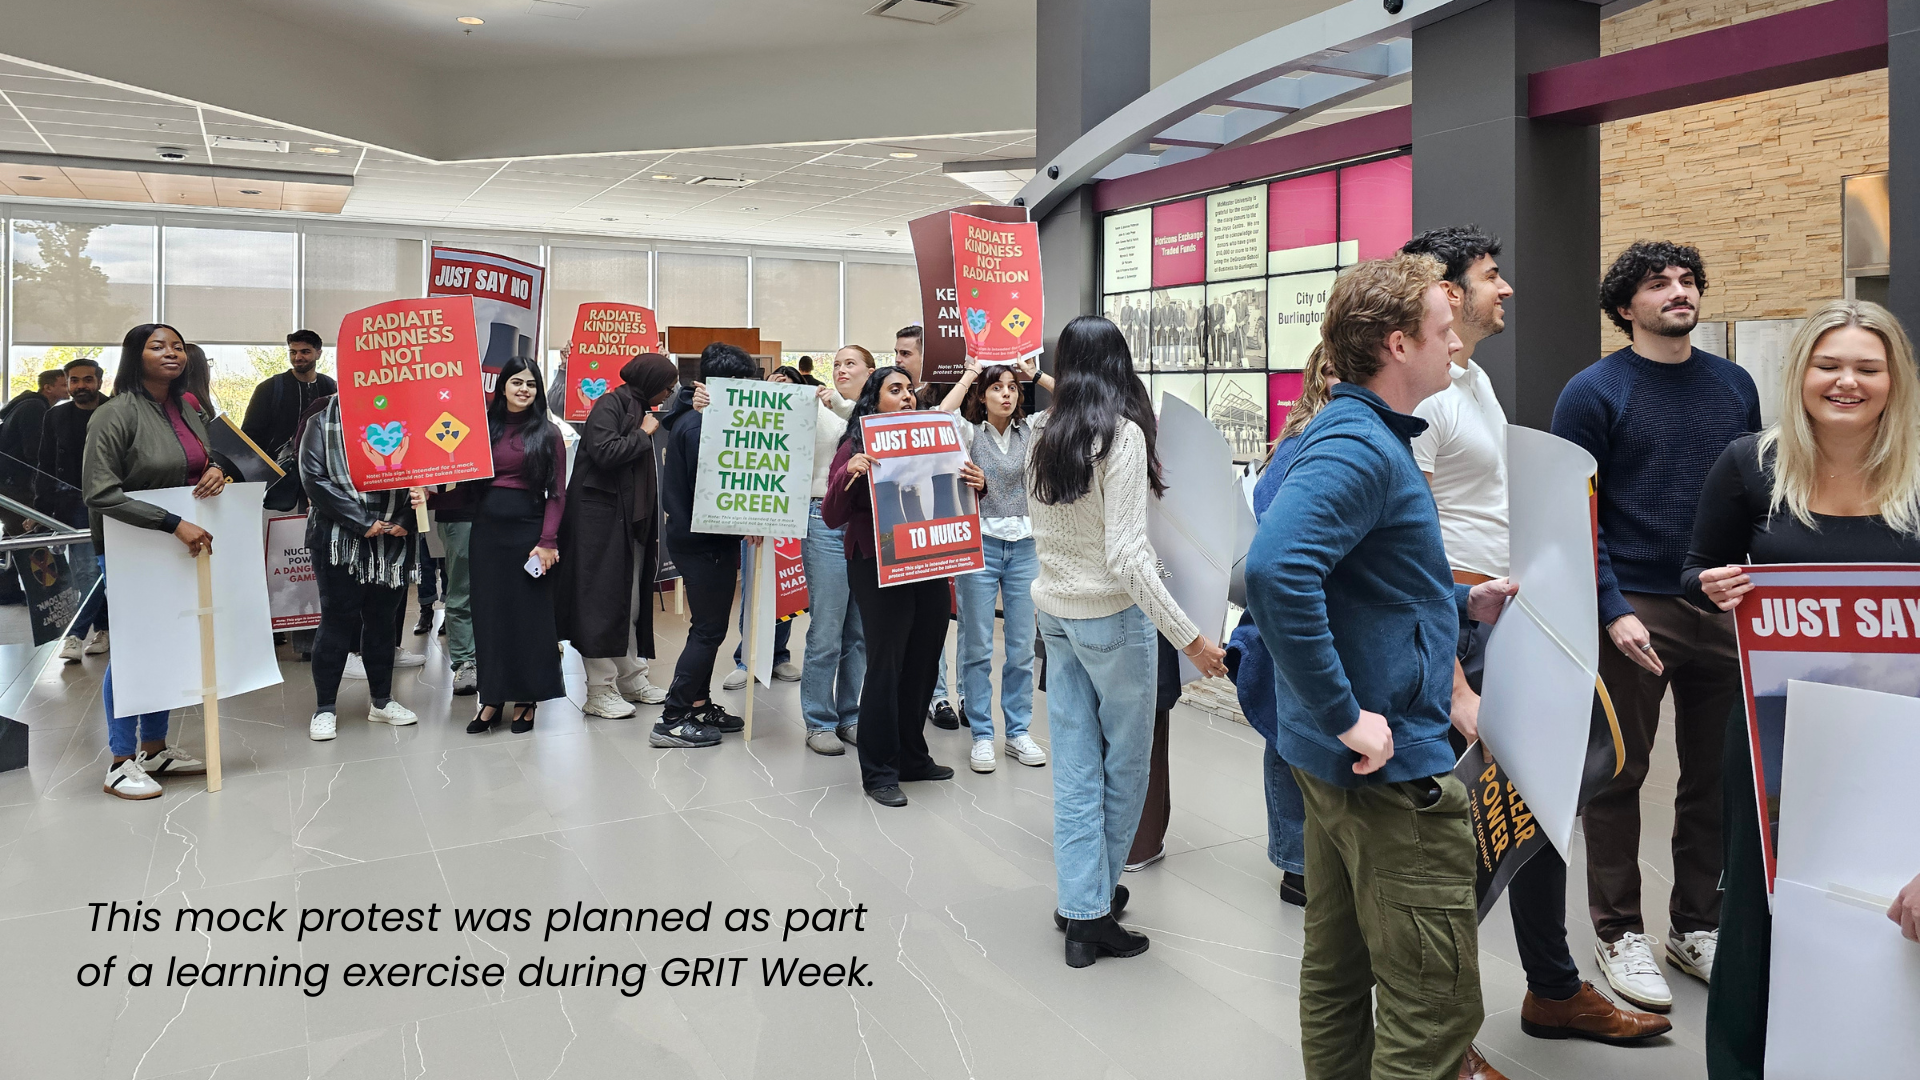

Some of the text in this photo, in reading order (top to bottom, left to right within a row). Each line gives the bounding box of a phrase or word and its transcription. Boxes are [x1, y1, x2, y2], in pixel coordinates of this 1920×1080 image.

[968, 225, 1016, 244] RADIATE
[1155, 231, 1204, 246] Horizons Exchange
[965, 238, 1023, 257] KINDNESS
[1162, 243, 1196, 256] Traded Funds
[977, 255, 1002, 270] NOT
[434, 265, 529, 300] JUST SAY NO
[963, 265, 1029, 283] RADIATION
[1296, 290, 1326, 306] City of
[362, 309, 443, 332] RADIATE
[590, 309, 641, 322] RADIATE
[938, 307, 960, 319] AN
[583, 320, 647, 334] KINDNESS
[356, 326, 454, 351] KINDNESS
[599, 332, 627, 344] NOT
[381, 346, 424, 366] NOT
[579, 343, 650, 356] RADIATION
[354, 361, 463, 388] RADIATION
[726, 388, 793, 411] THINK
[730, 409, 785, 430] SAFE
[722, 429, 790, 451] THINK
[871, 426, 956, 452] JUST SAY NO
[412, 466, 439, 474] intended
[718, 450, 790, 472] CLEAN
[718, 471, 786, 492] THINK
[716, 492, 789, 514] GREEN
[909, 521, 972, 549] TO NUKES
[284, 548, 312, 556] NUCL
[288, 556, 311, 565] POW
[283, 565, 313, 574] DANG
[779, 562, 805, 578] NUC
[1751, 598, 1920, 638] JUST SAY
[1480, 763, 1509, 862] POWER
